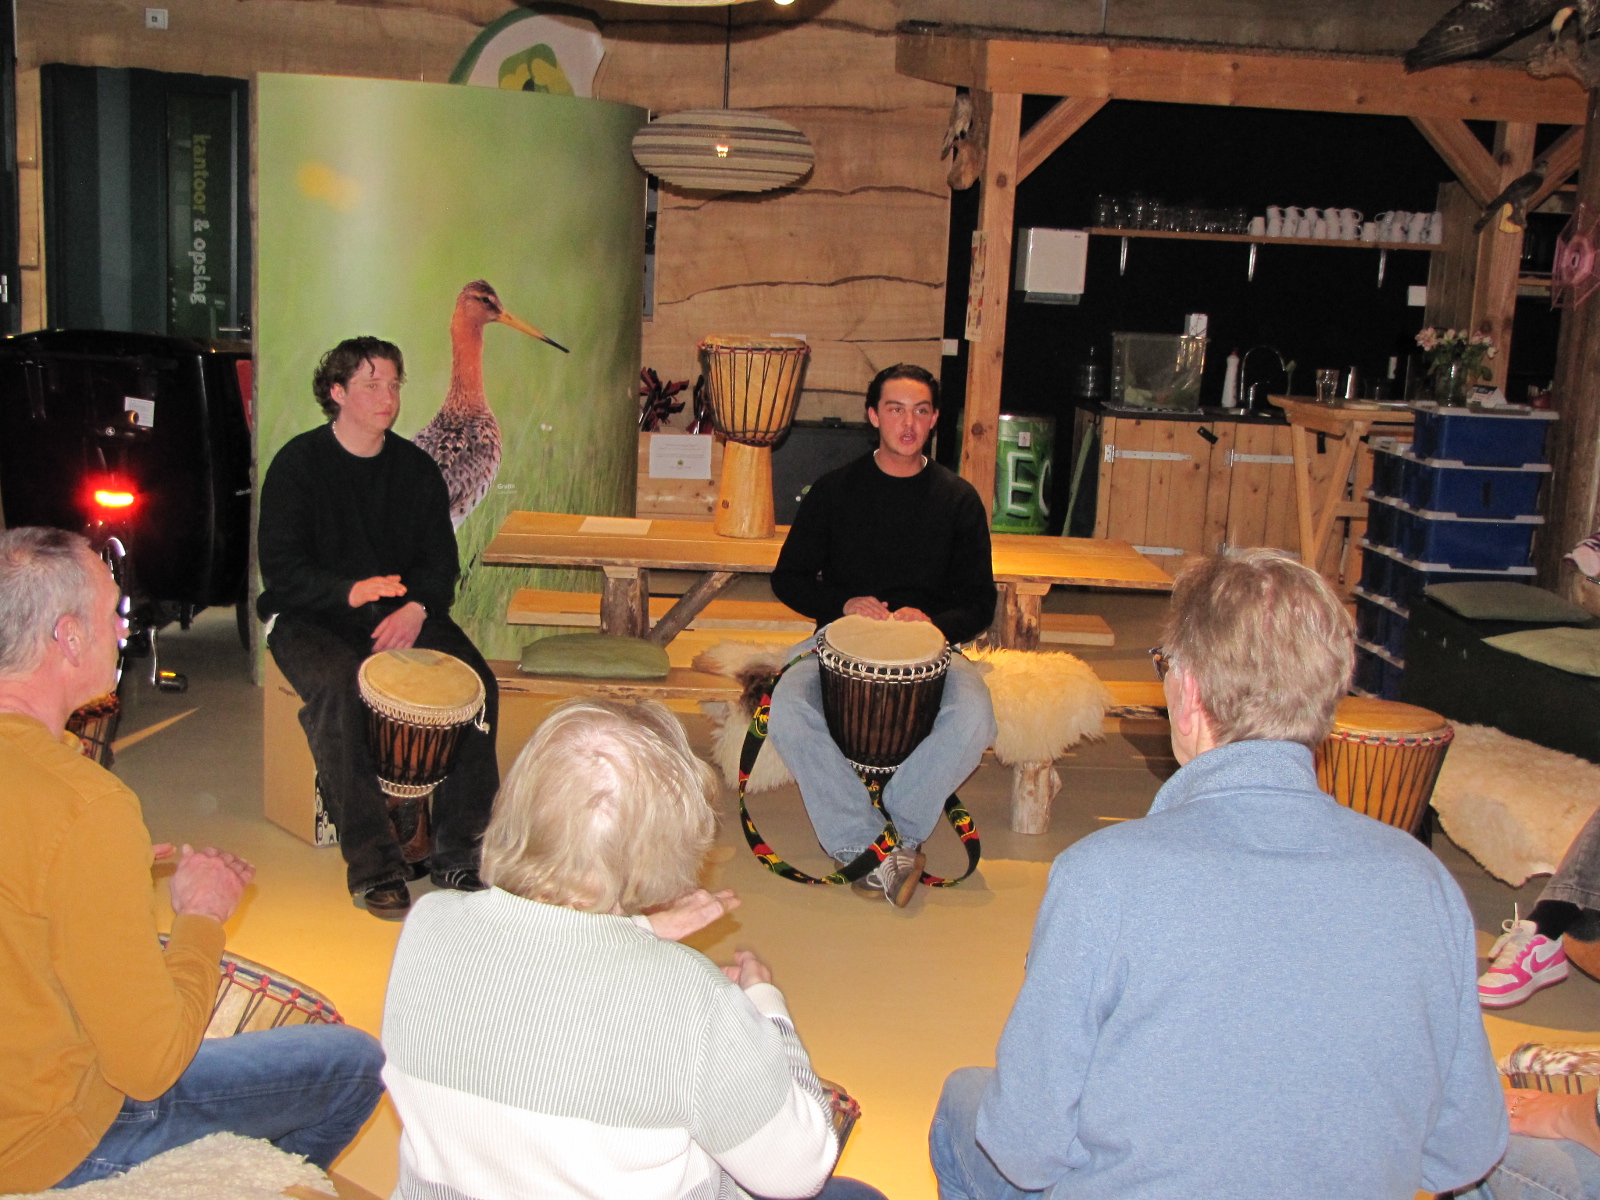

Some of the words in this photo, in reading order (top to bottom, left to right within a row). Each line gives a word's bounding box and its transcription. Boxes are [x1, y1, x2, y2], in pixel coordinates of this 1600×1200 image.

[193, 134, 211, 214] kantoor
[193, 218, 210, 232] &
[188, 237, 211, 305] opslag
